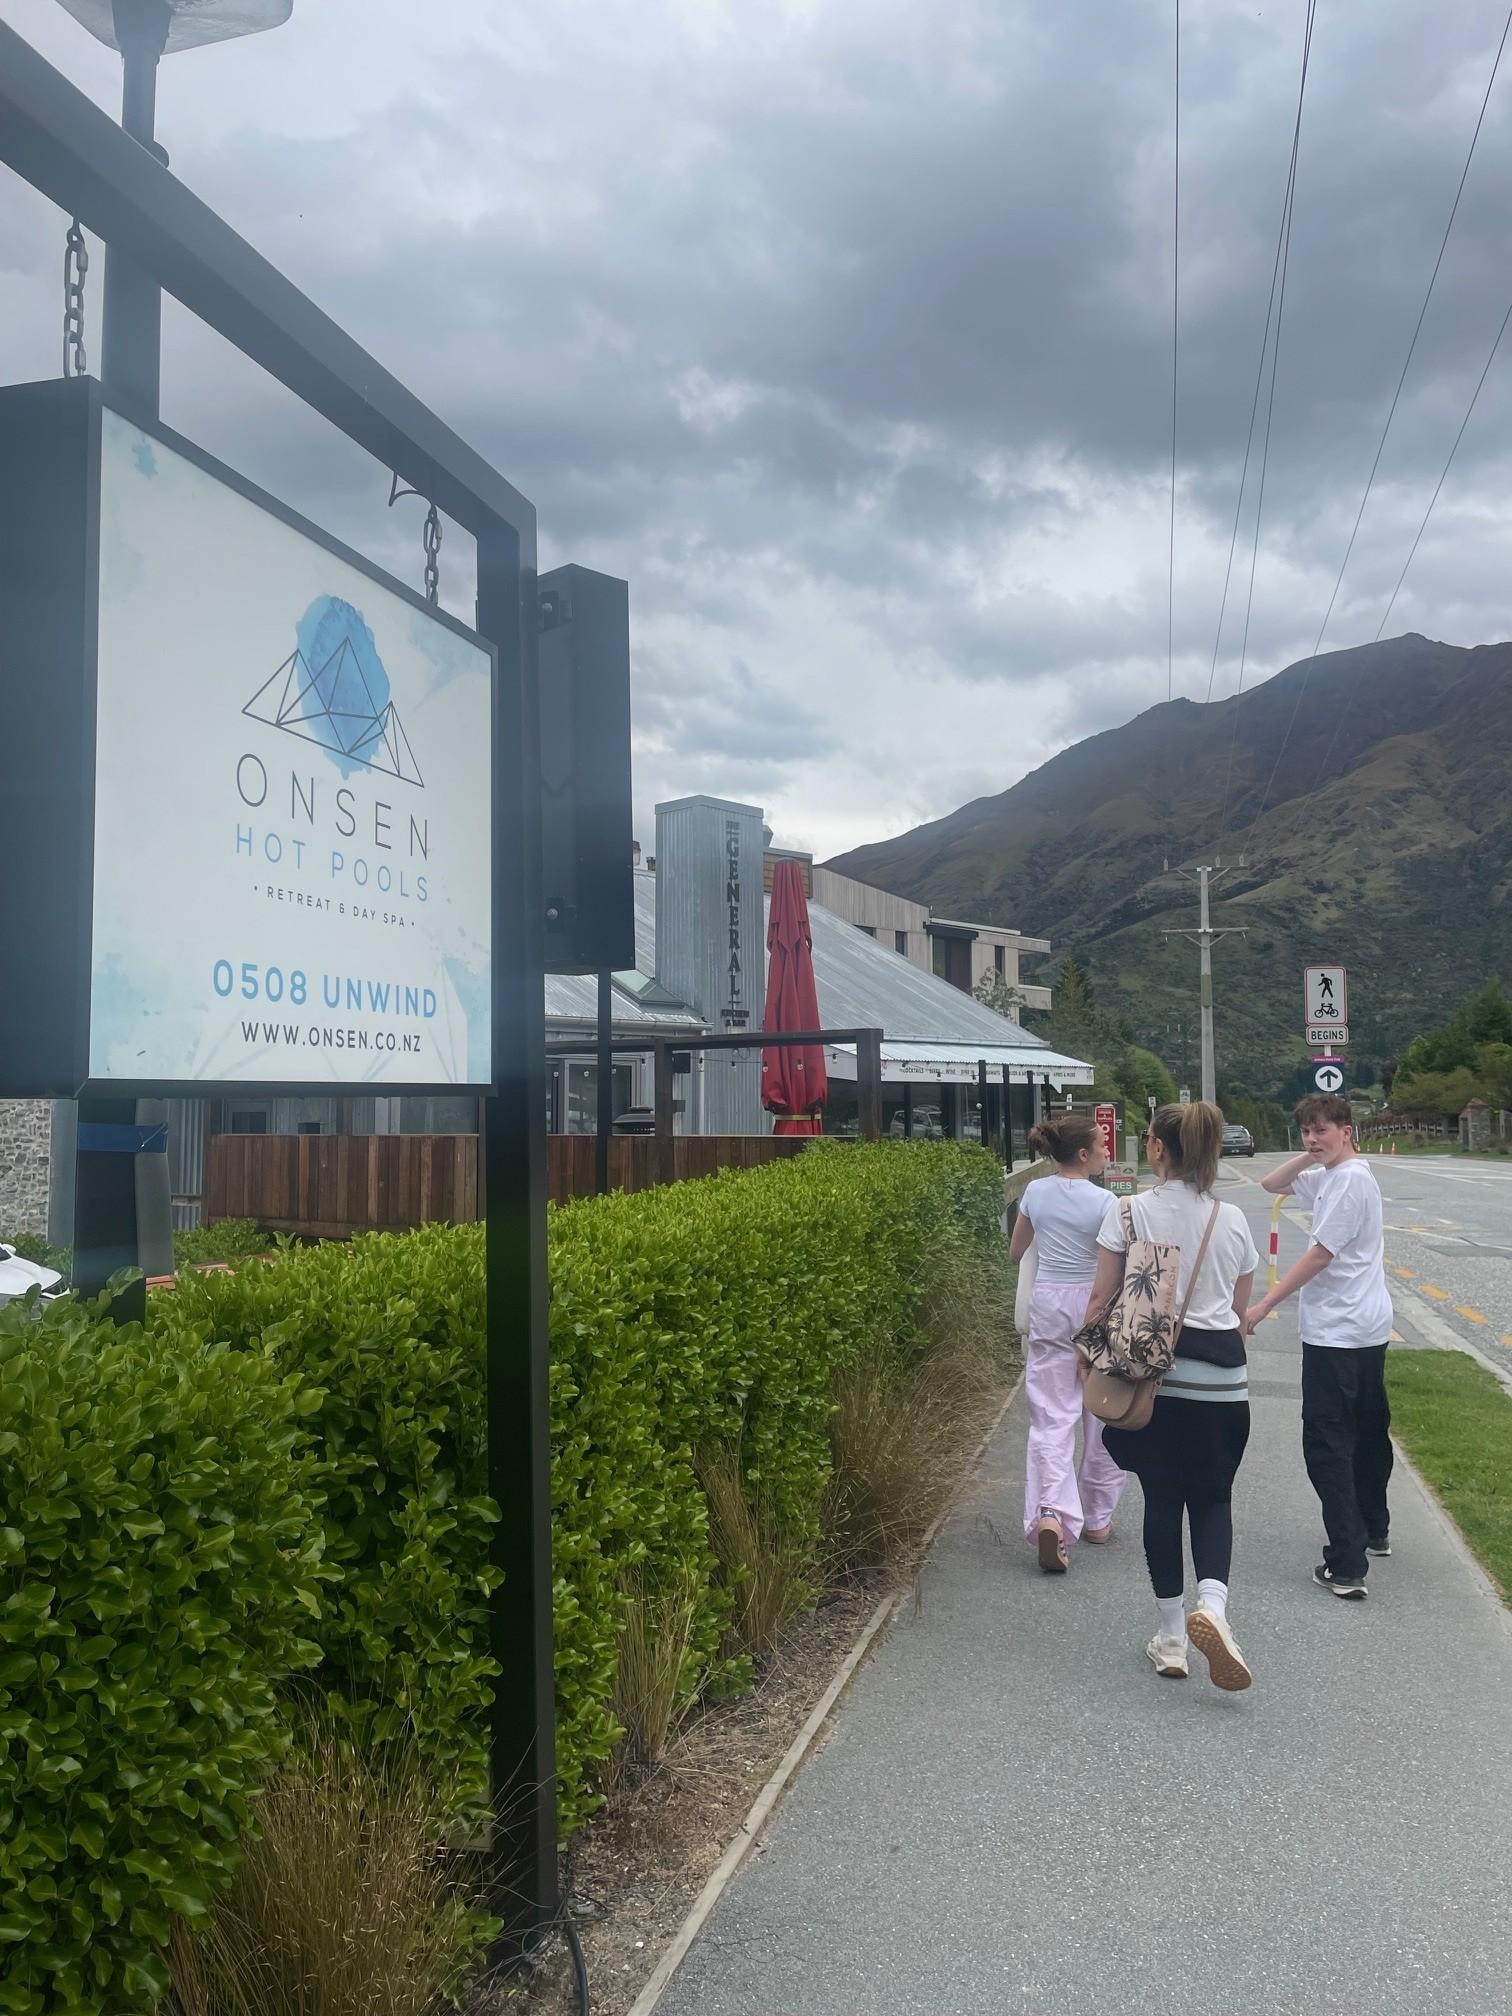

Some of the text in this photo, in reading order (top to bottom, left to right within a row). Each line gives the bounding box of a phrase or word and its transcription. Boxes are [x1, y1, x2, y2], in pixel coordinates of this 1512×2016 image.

[236, 753, 429, 861] ONSEN
[235, 823, 430, 903] HOT POOLS
[267, 886, 406, 928] RETREAT & DAY SPA
[726, 837, 741, 996] GENERAL
[212, 959, 438, 1019] 0508 UNWIND
[241, 1020, 422, 1053] WWW.ONSEN.CO.NZ
[1311, 1030, 1344, 1040] BEGINS
[1110, 1181, 1132, 1190] PIES
